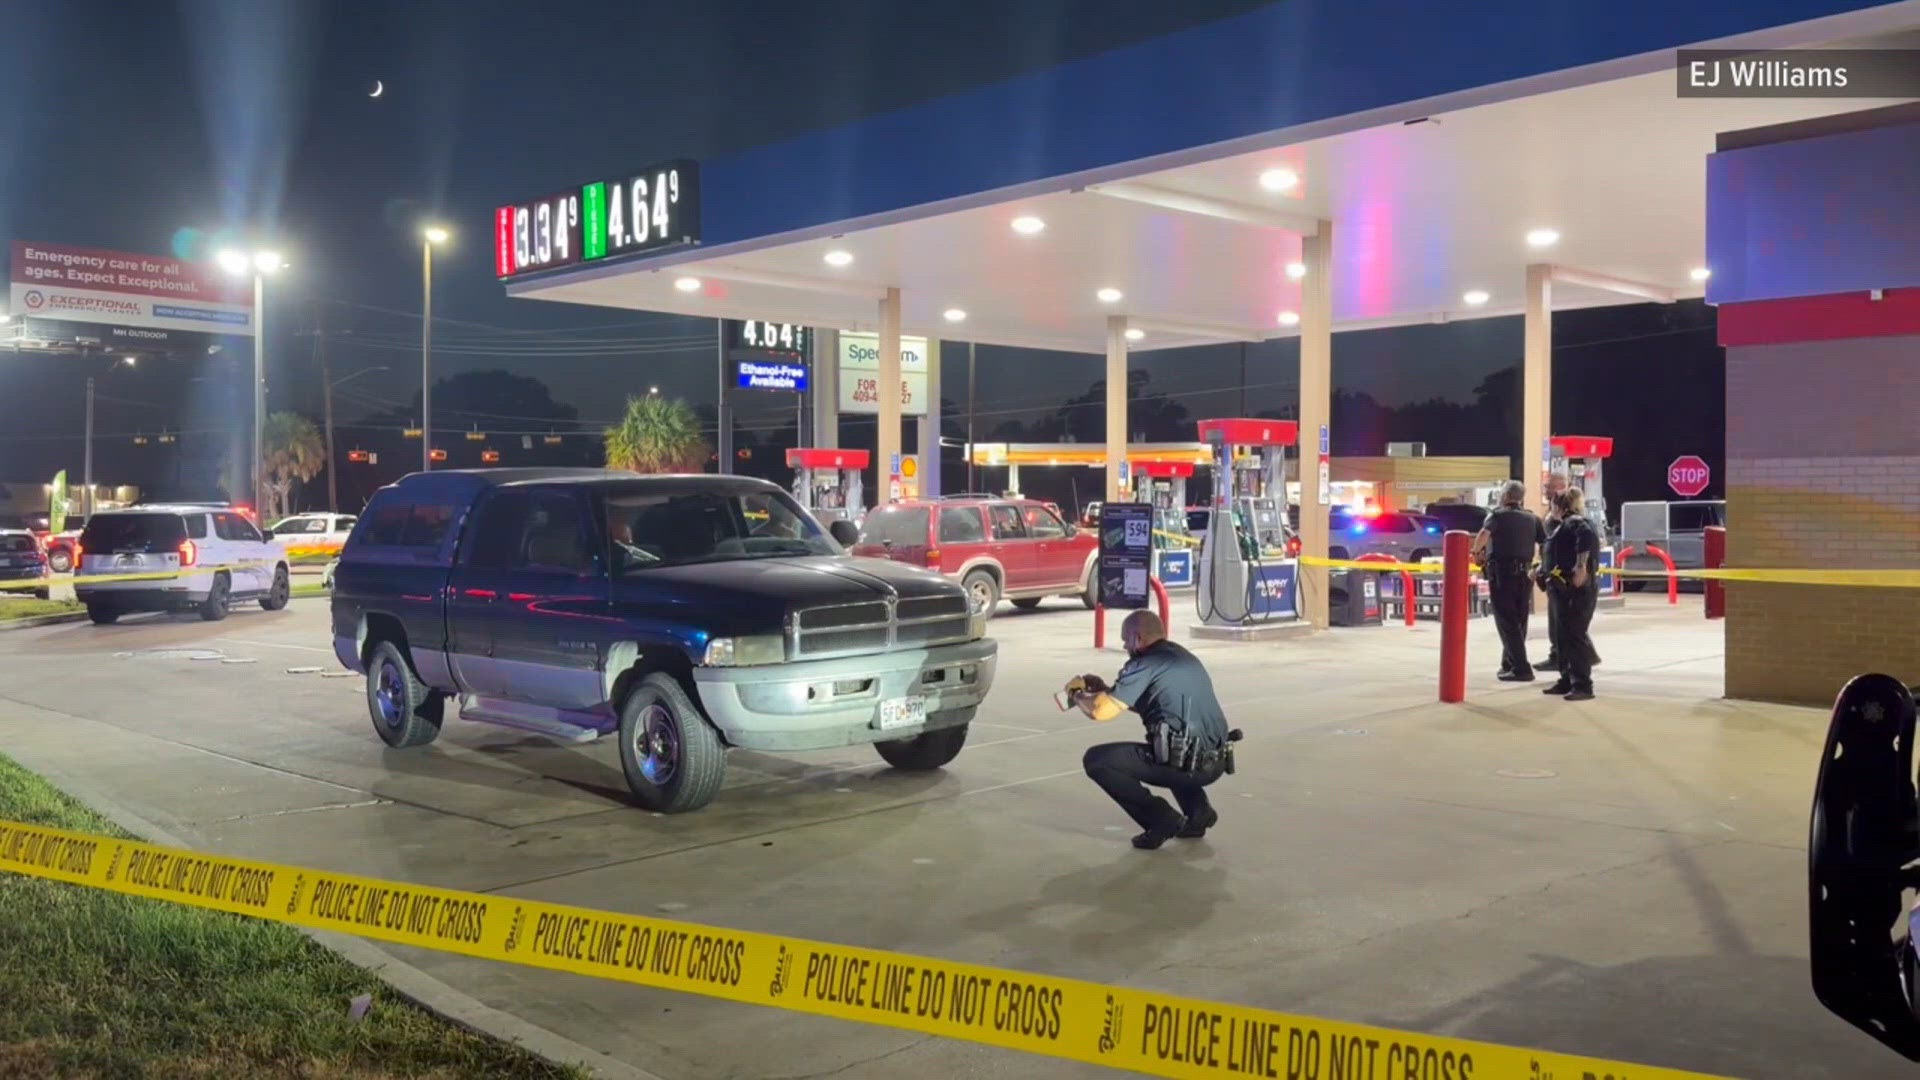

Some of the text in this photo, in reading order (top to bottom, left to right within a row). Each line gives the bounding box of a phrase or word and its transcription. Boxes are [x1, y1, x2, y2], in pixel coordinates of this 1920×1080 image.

[25, 248, 179, 276] Emergency care for all
[25, 267, 198, 293] ages. Expect Exceptional.
[50, 295, 141, 310] EXCEPTIONAL
[129, 329, 168, 340] OUTDOOR
[848, 344, 914, 362] Specm
[740, 362, 803, 378] Ethanol-Free
[750, 375, 796, 388] Available
[857, 378, 876, 391] FOR
[1671, 468, 1706, 483] STOP
[2, 827, 28, 861] LINE
[23, 832, 43, 865] DO
[38, 835, 65, 868] NOT
[59, 838, 97, 876] CROSS
[125, 849, 275, 908] POLICE LINE DO NOT CROSS
[310, 879, 487, 944] POLICE LINE DO NOT CROSS
[533, 912, 589, 960] POLICE
[588, 920, 627, 967] LINE
[625, 926, 651, 971] DO
[650, 929, 689, 977] NOT
[687, 934, 745, 986] CROSS
[804, 951, 870, 1007] POLICE
[871, 961, 915, 1015] LINE
[917, 969, 946, 1020] DO
[949, 974, 992, 1027] NOT
[993, 980, 1063, 1041] CROSS
[1141, 1003, 1222, 1068] POLICE
[1227, 1017, 1280, 1078] LINE
[1286, 1027, 1321, 1080] DO
[1328, 1033, 1380, 1080] NOT
[1386, 1041, 1474, 1080] CROSS
